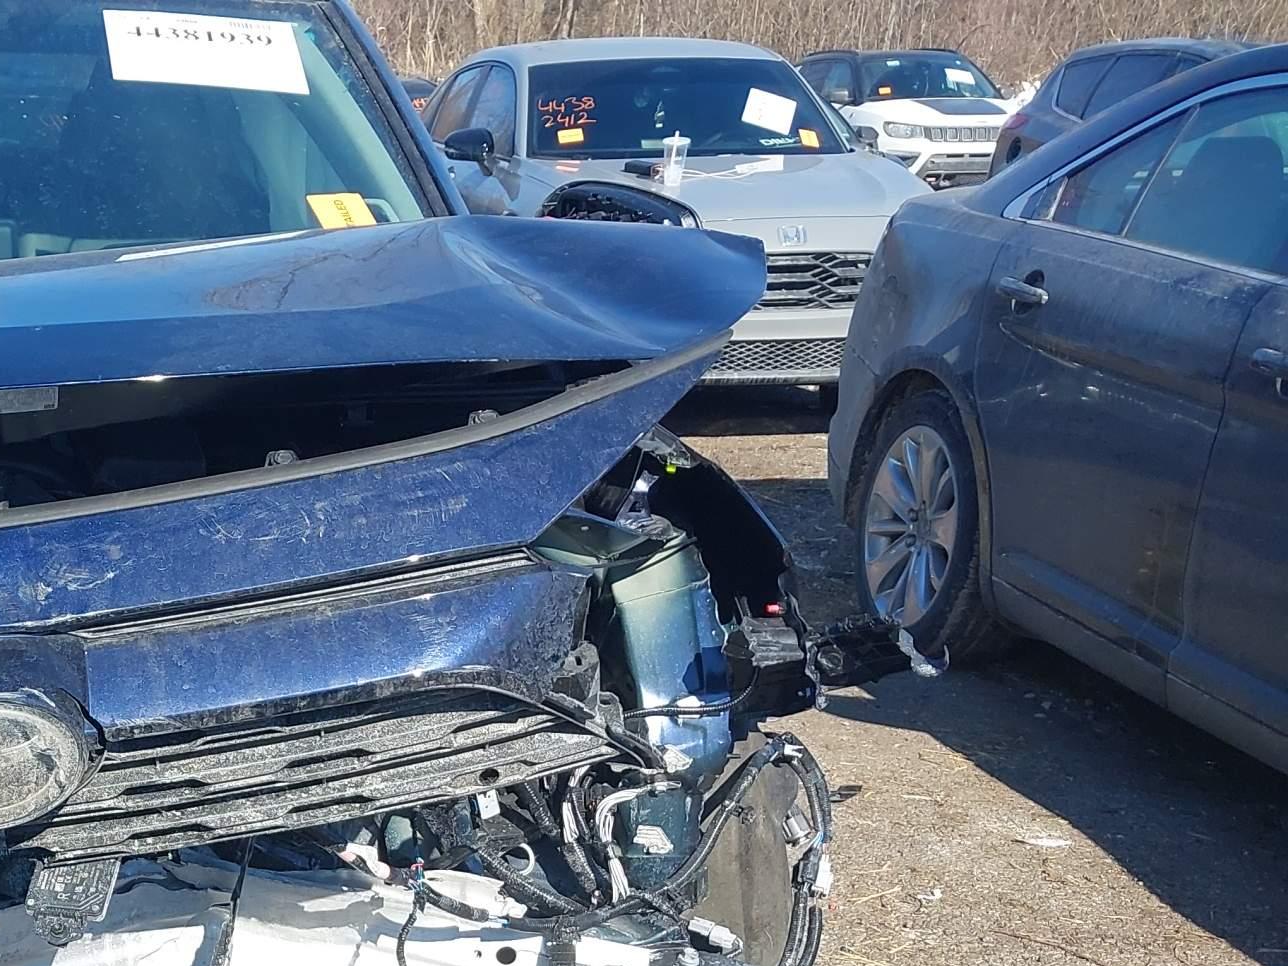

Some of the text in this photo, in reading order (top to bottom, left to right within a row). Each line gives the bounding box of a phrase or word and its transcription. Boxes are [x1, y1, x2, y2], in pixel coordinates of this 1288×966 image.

[127, 26, 273, 47] 44381939
[537, 96, 596, 113] 4438
[541, 112, 597, 127] 2412
